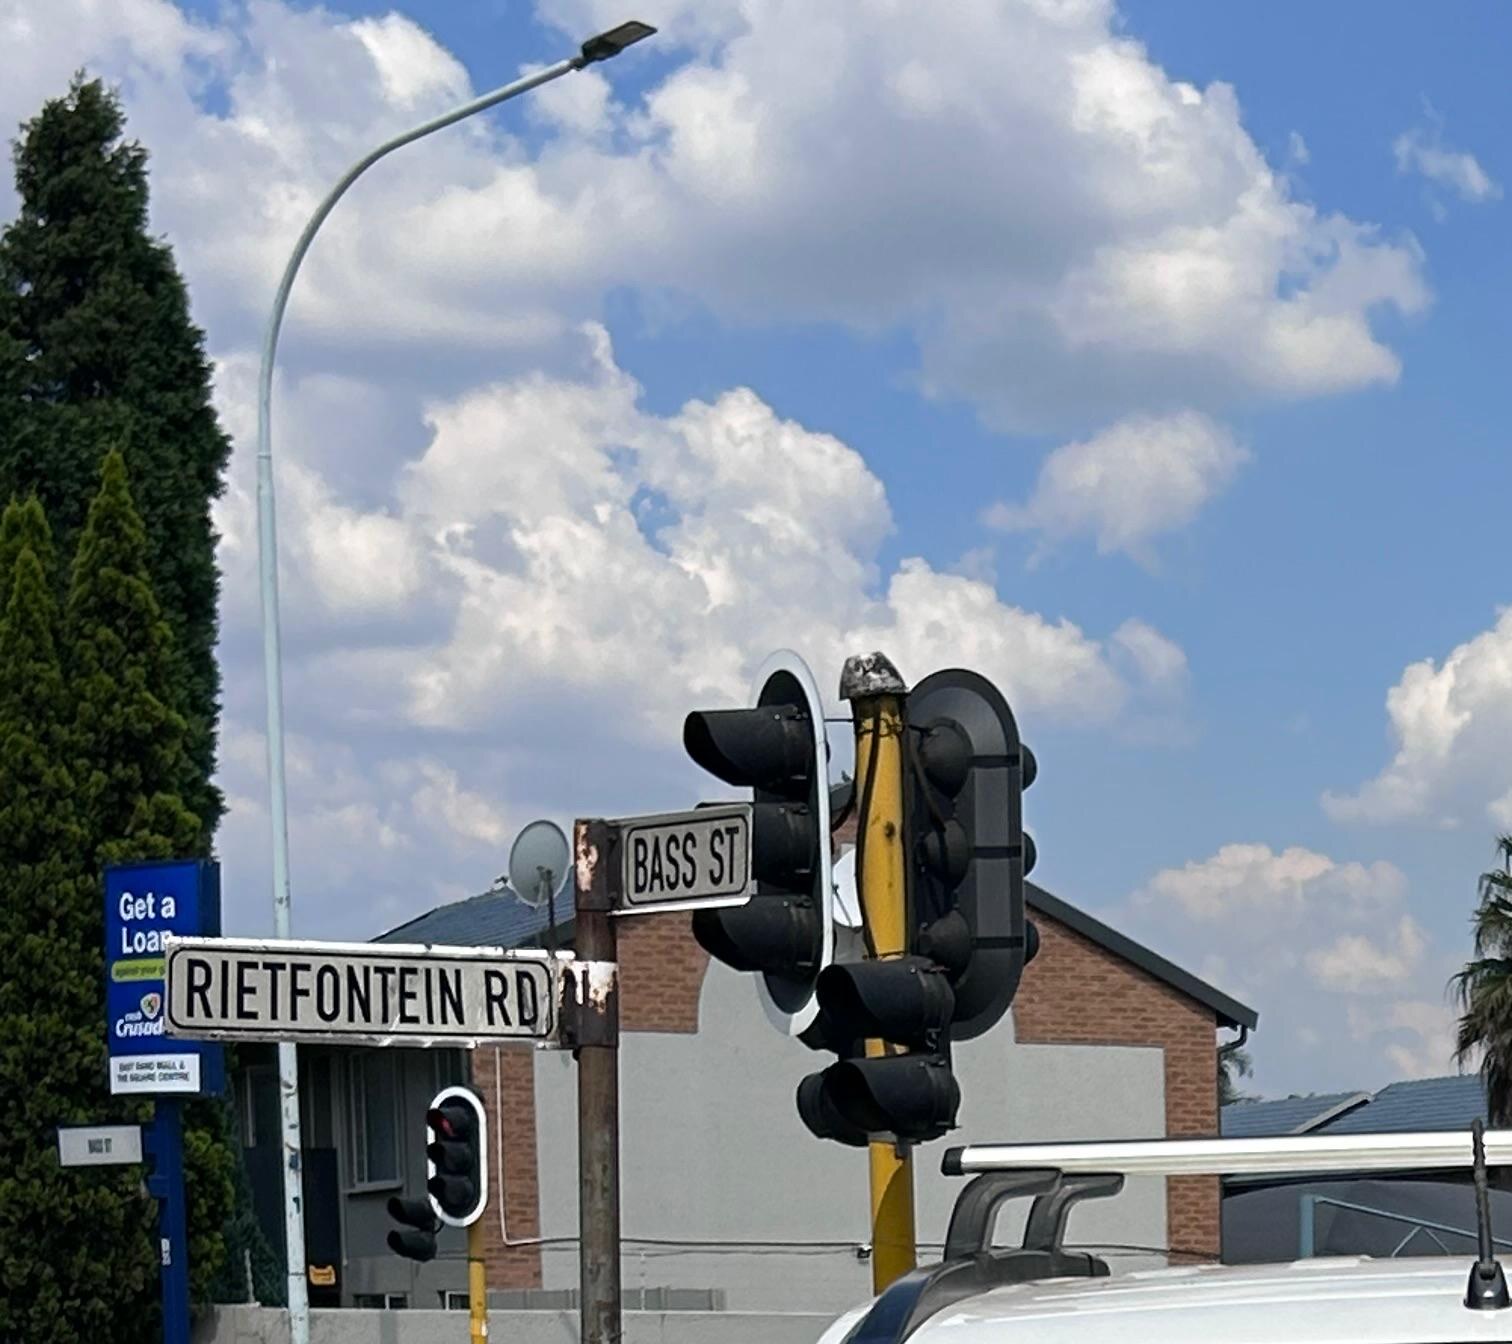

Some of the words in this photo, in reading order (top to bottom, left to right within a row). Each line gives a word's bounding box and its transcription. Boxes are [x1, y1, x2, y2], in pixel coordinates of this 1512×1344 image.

[634, 829, 697, 895] BASS
[709, 826, 740, 887] ST
[119, 891, 156, 922] Get
[161, 895, 176, 919] a
[186, 958, 465, 1027] RIETFONTEIN
[485, 969, 540, 1027] RD
